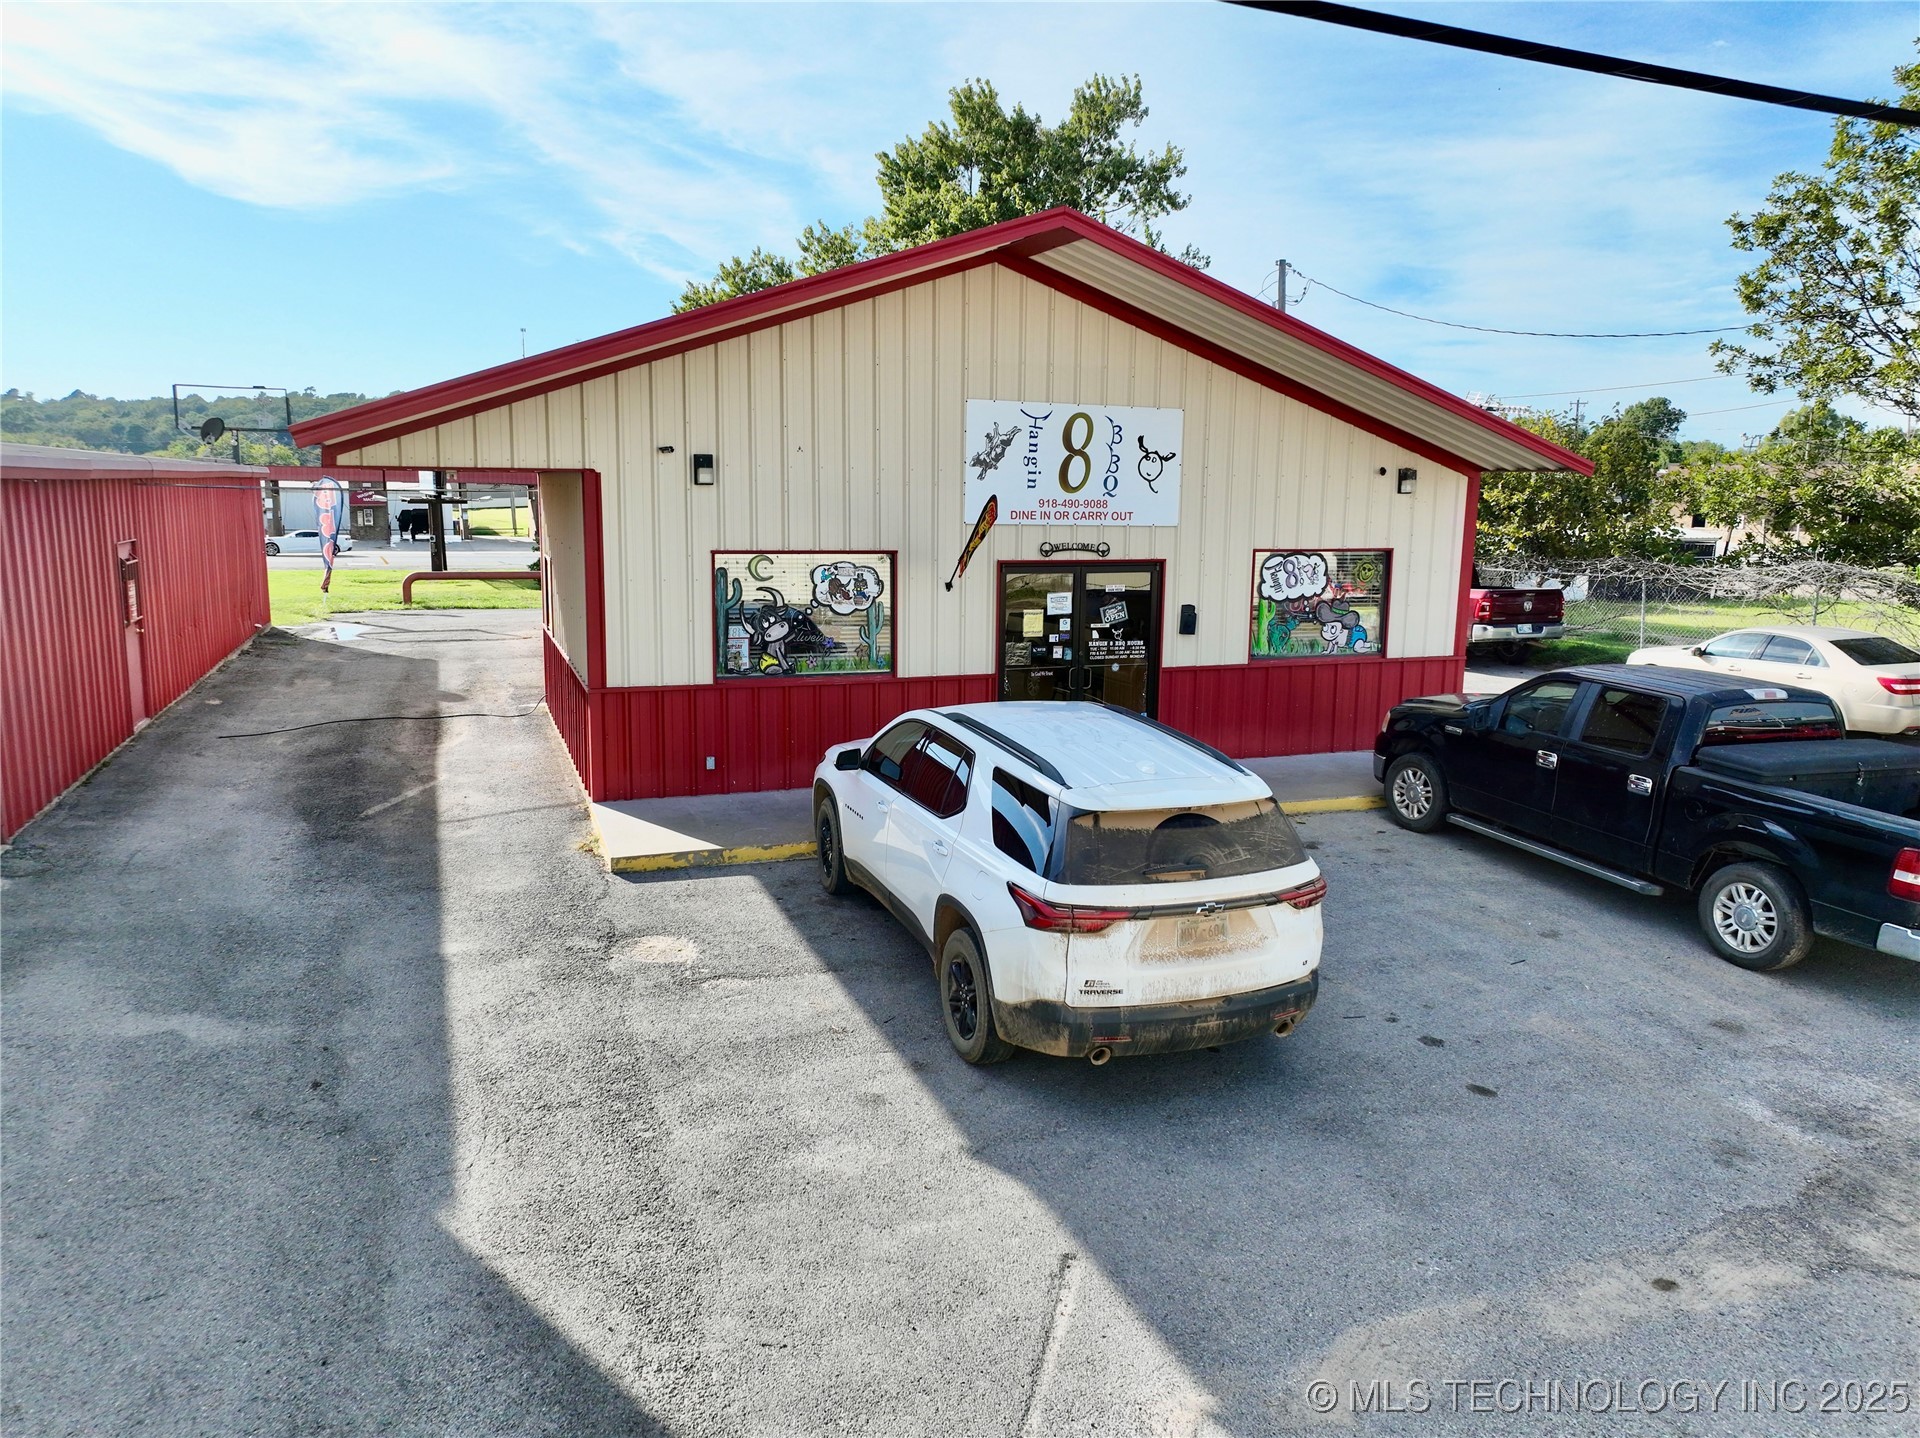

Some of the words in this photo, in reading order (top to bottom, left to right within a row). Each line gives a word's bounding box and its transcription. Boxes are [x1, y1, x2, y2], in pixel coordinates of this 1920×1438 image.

[1020, 408, 1053, 489] Hangin
[1058, 412, 1094, 494] 8
[1103, 415, 1123, 498] BBQ
[1038, 499, 1108, 509] 918-490-9088
[1010, 510, 1037, 520] DINE
[1040, 510, 1051, 520] IN
[1054, 511, 1070, 521] OR
[1072, 511, 1109, 521] CARRY
[1111, 511, 1134, 521] OUT
[1053, 542, 1096, 550] WELCOME
[1283, 559, 1298, 589] 8
[1104, 611, 1125, 622] OPEN
